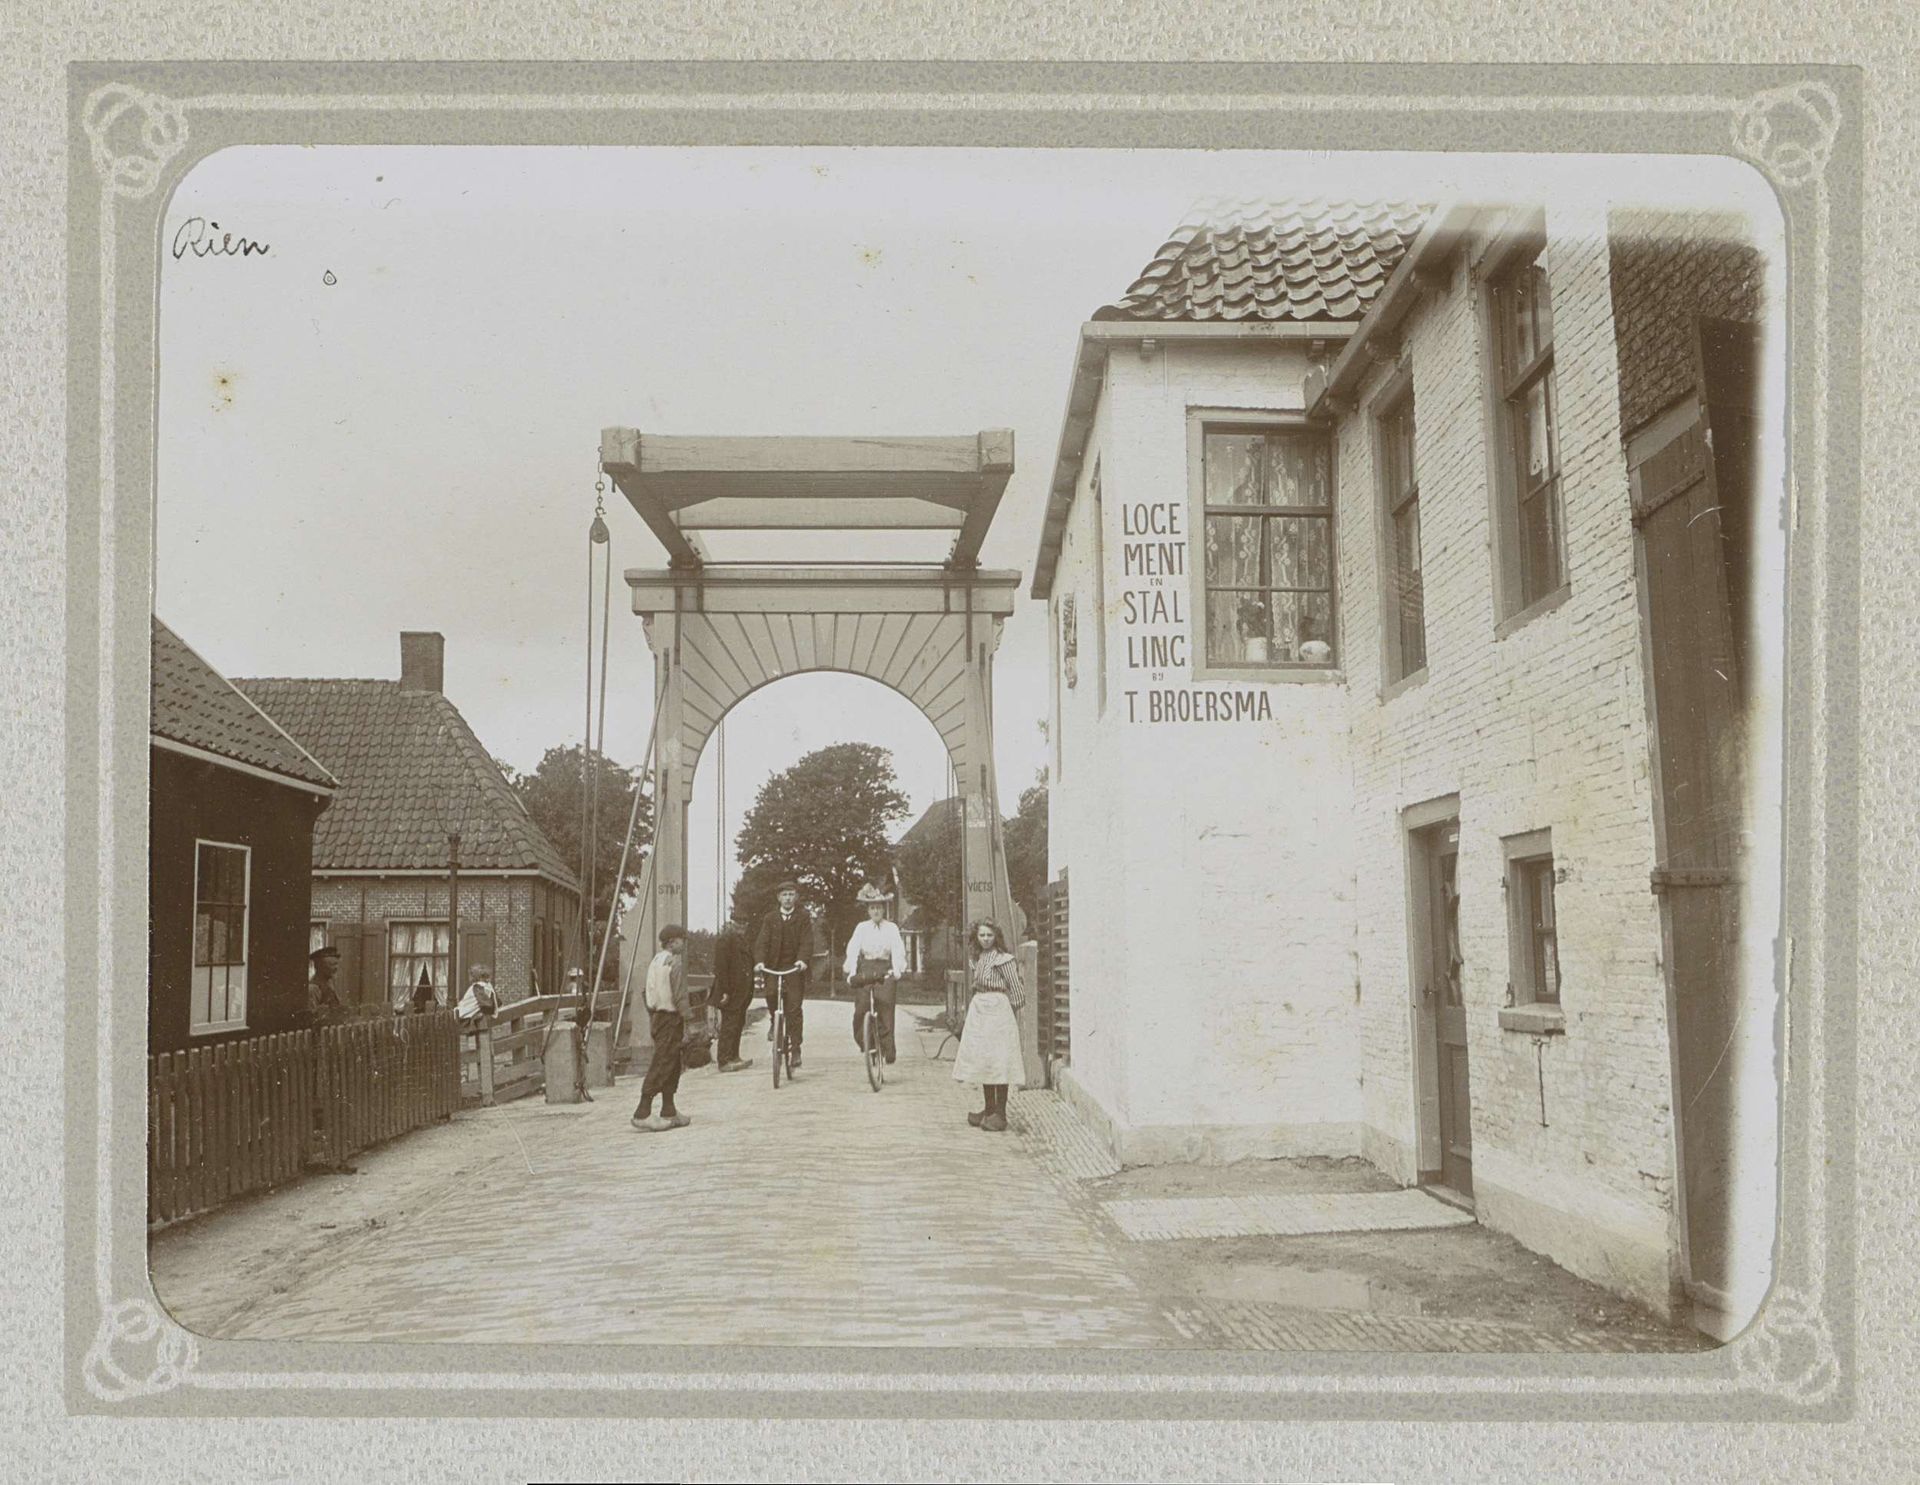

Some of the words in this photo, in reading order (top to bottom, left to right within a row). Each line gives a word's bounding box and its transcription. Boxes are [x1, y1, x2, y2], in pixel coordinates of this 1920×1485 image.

[173, 217, 270, 259] Rien
[1123, 503, 1181, 535] LOGE
[1124, 542, 1186, 576] MENT
[1150, 578, 1163, 586] EN
[1123, 590, 1184, 624] STAL
[1128, 635, 1185, 668] LING
[1149, 689, 1272, 723] BROERSMA
